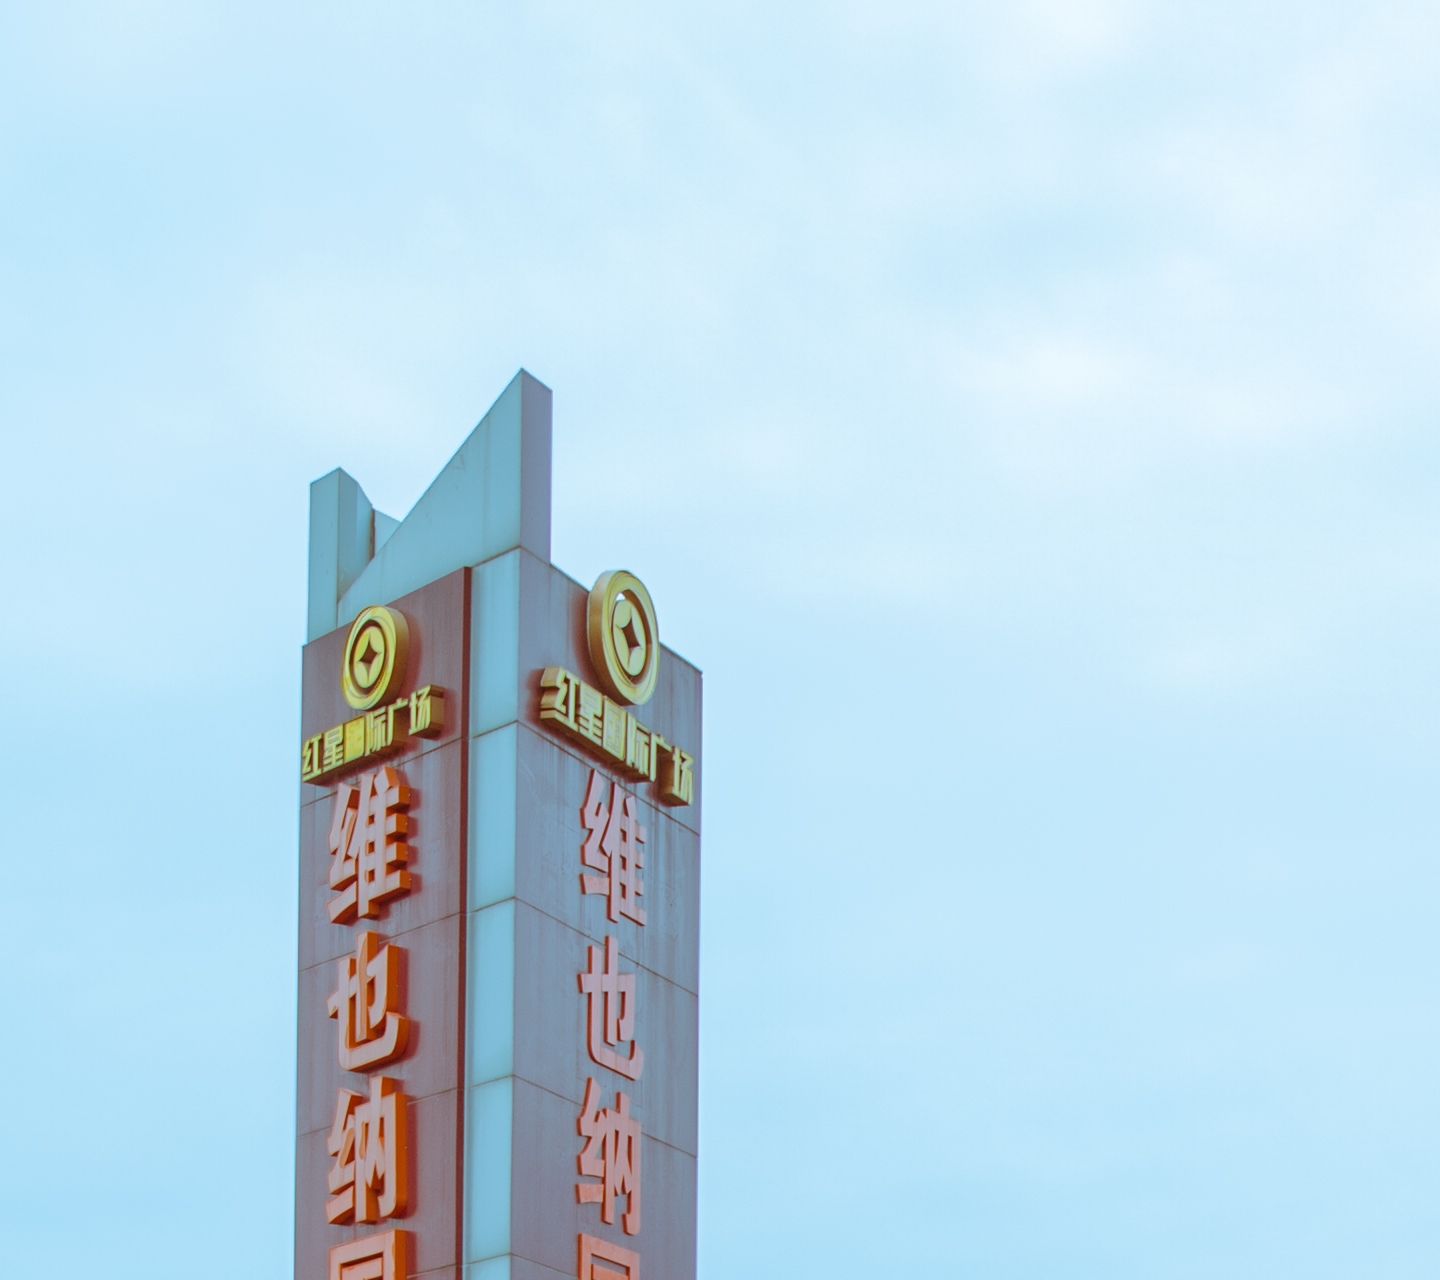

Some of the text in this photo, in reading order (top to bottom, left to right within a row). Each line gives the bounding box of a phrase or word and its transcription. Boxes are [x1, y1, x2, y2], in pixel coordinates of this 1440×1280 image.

[302, 685, 440, 785] 红星国际广场
[540, 667, 695, 806] 红星国际广场
